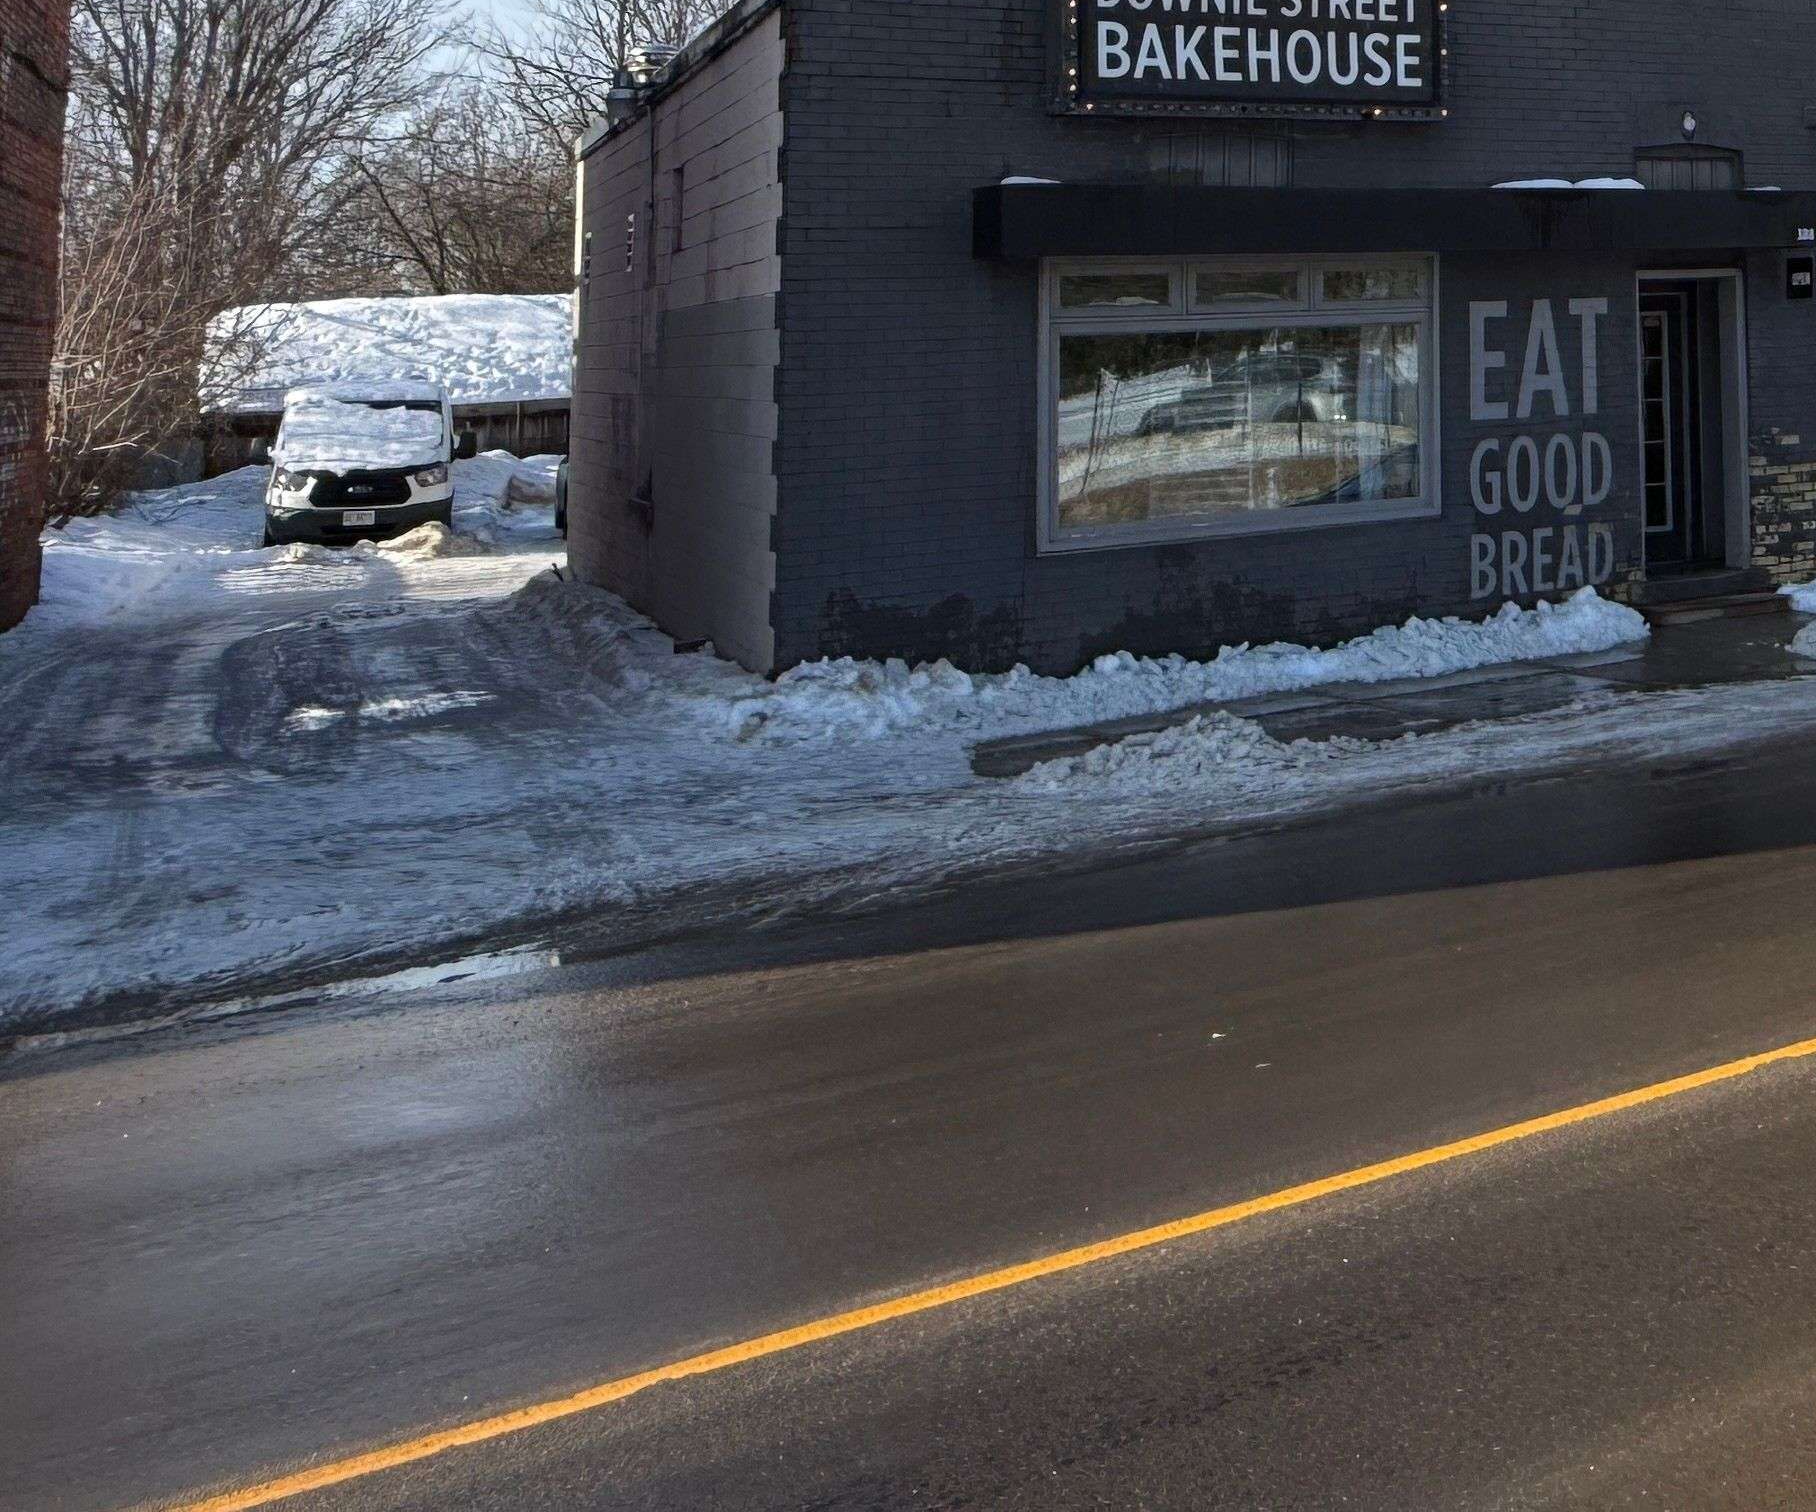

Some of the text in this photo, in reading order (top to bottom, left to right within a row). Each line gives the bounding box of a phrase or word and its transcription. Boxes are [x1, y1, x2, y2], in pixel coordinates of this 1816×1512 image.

[1097, 21, 1422, 87] BAKEHOUSE
[1469, 297, 1608, 420] EAT
[1470, 431, 1612, 515] GOOD
[1470, 523, 1613, 599] BREAD
